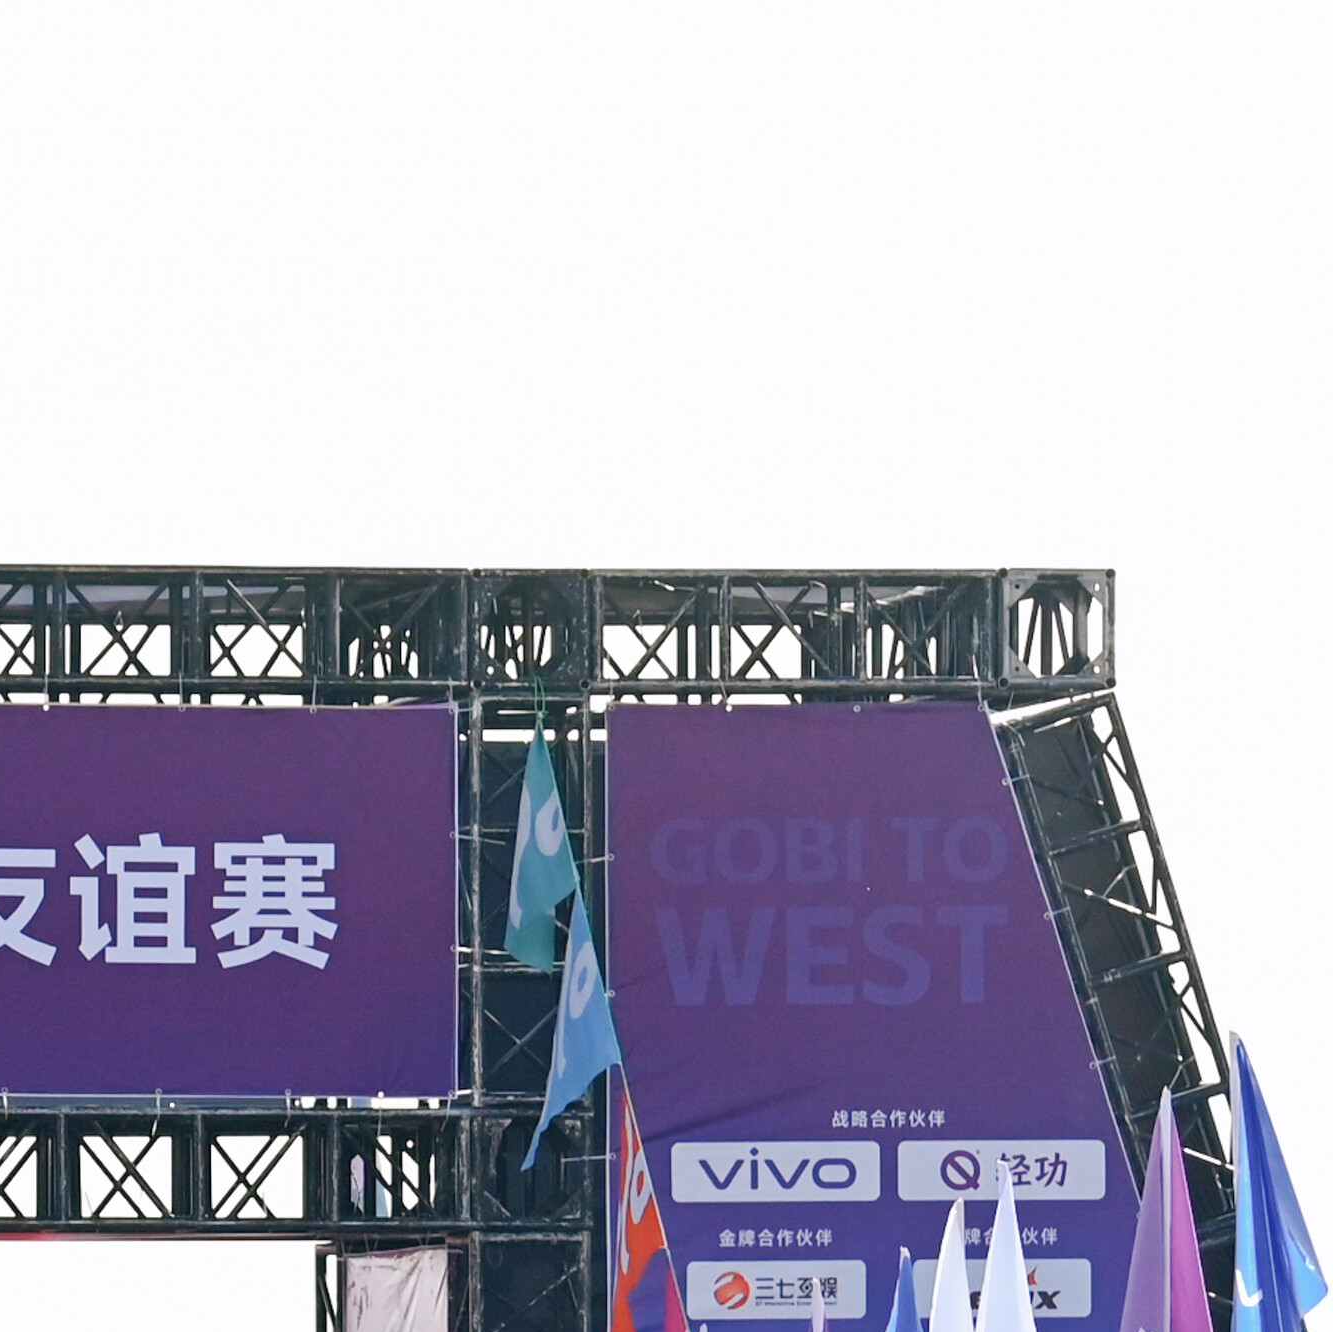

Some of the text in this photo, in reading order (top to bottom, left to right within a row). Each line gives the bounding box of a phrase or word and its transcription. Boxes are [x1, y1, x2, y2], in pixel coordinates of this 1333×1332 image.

[649, 816, 1009, 887] GOBI TO
[653, 904, 1010, 1007] WEST
[831, 1109, 947, 1130] 战略合作伙伴
[698, 1147, 858, 1190] vivo
[718, 1228, 834, 1248] 金牌合作伙伴
[963, 1227, 1059, 1246] 牌伙伴
